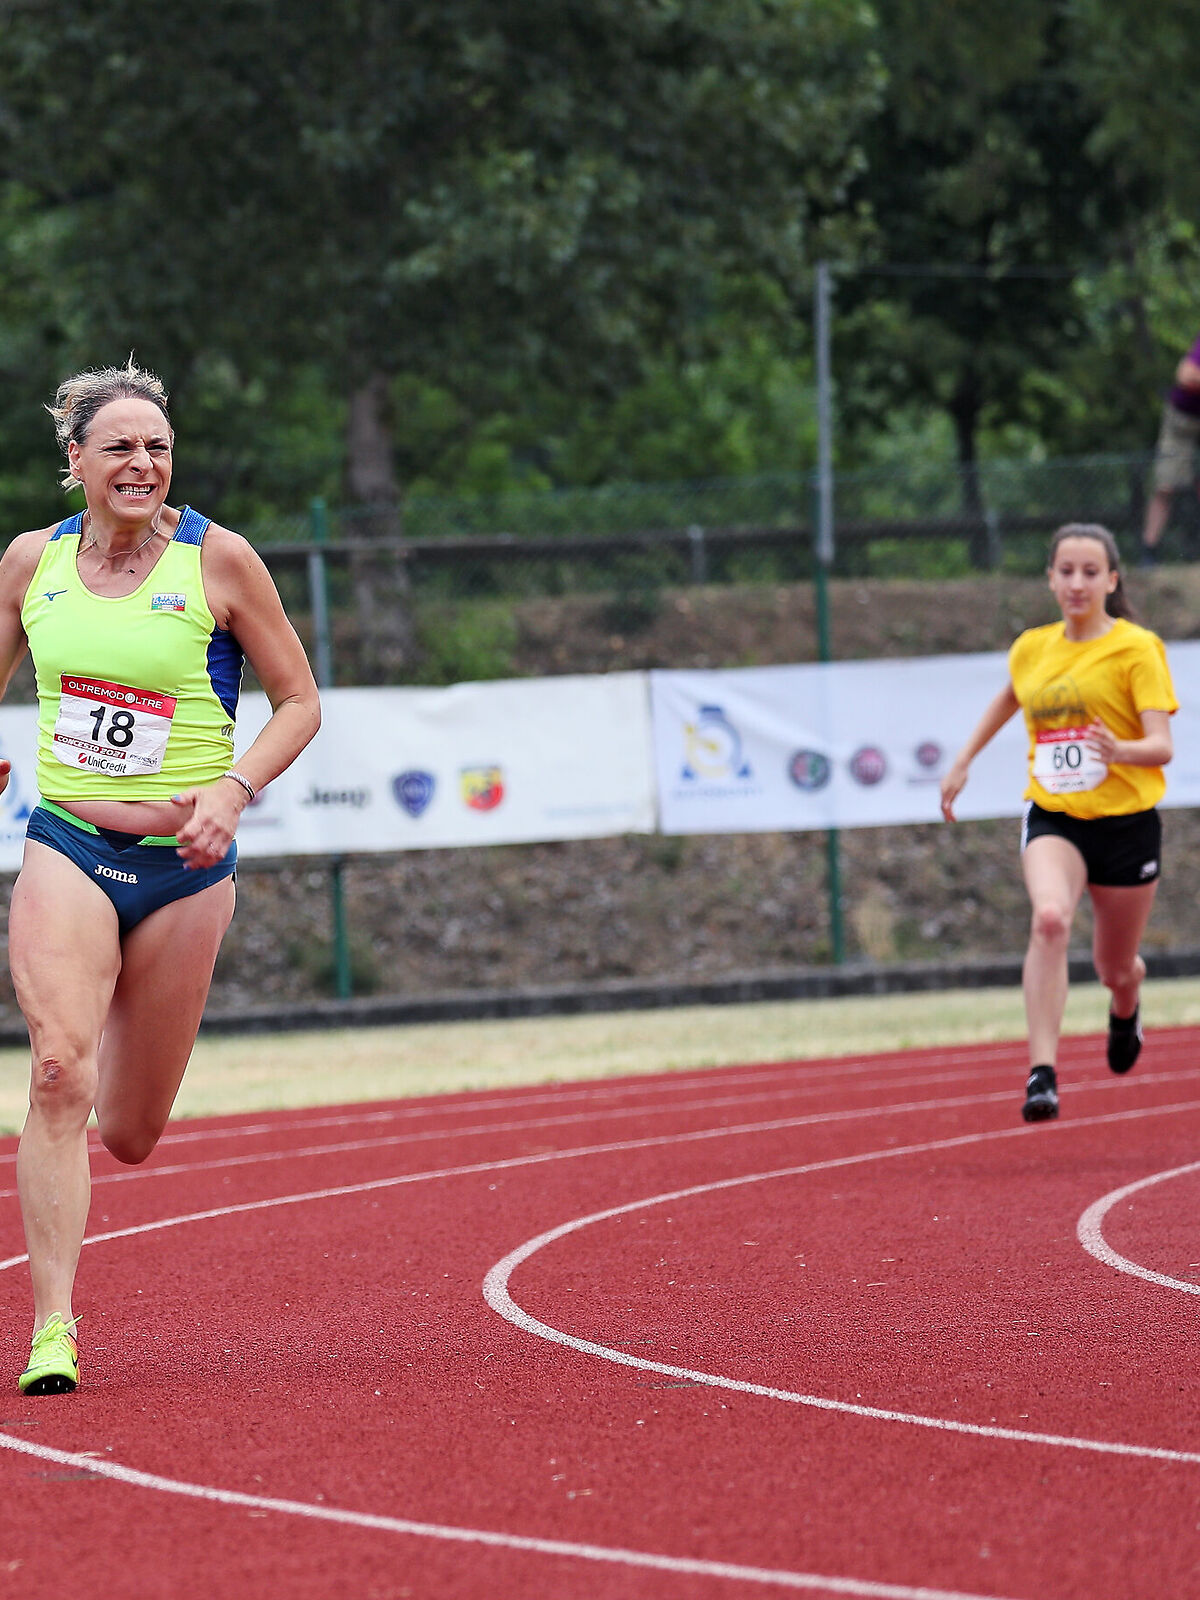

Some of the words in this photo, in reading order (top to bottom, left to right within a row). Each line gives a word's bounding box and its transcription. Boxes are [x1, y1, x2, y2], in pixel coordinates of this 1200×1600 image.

[90, 705, 135, 748] 18
[101, 746, 125, 760] 2021
[87, 755, 128, 775] UniCredit
[94, 863, 139, 885] Joma
